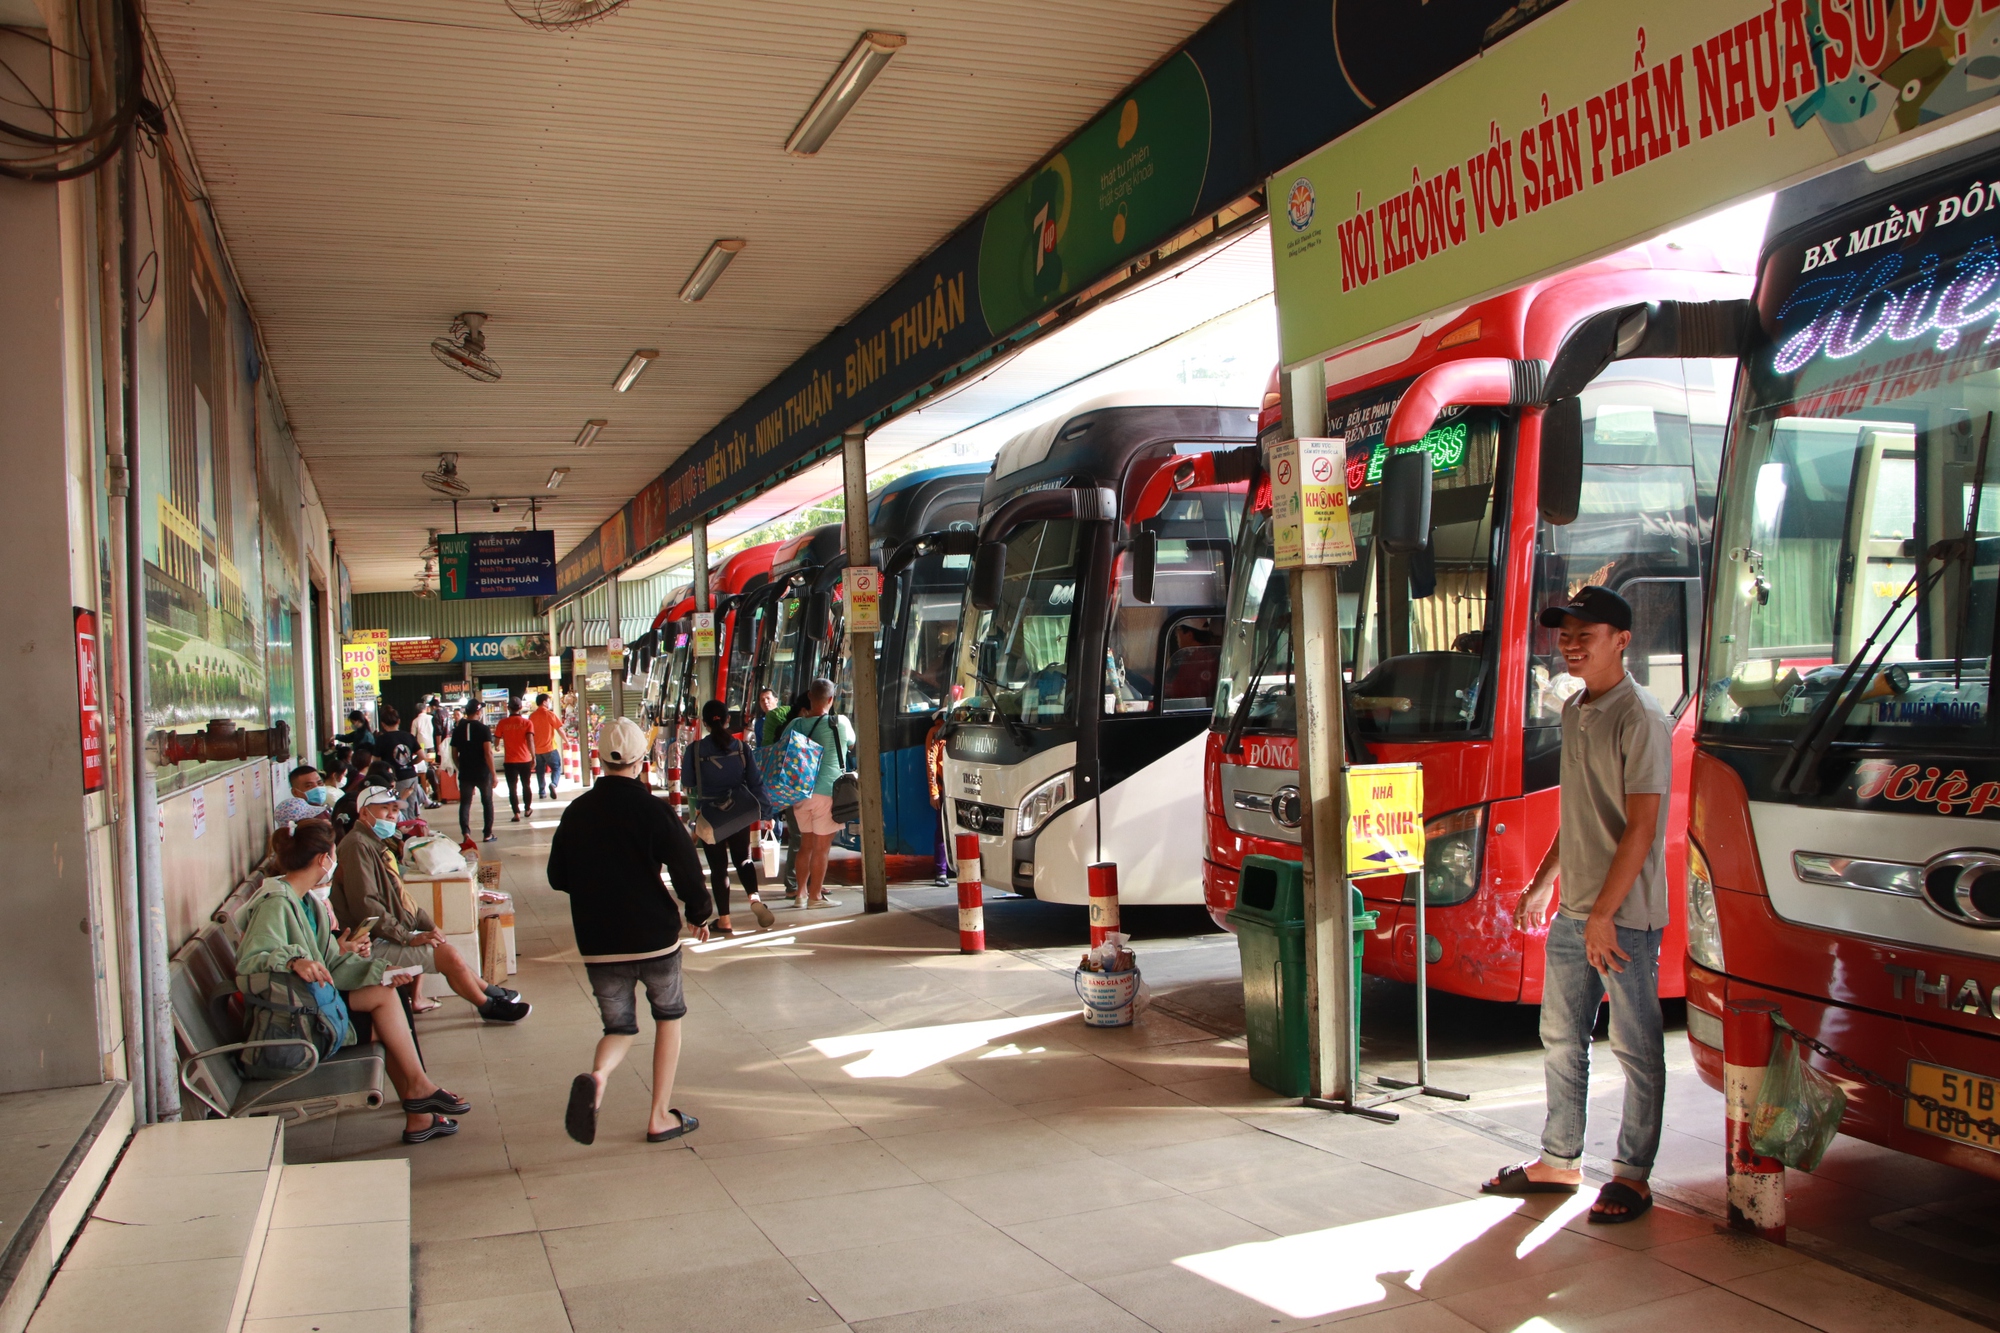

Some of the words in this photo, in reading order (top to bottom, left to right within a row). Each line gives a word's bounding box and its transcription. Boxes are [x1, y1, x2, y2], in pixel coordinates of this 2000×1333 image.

[1337, 191, 1379, 293] NÓI
[1379, 166, 1466, 276] KHÔNG
[1467, 120, 1518, 234] VỚI
[1520, 92, 1583, 214] SẢN
[1586, 26, 1691, 185] PHẨM
[1692, 0, 1817, 140] NHỰA
[1801, 237, 1842, 273] BX
[1845, 205, 1928, 257] MIỀN
[705, 440, 727, 489] MIỀN
[728, 430, 747, 475] TÂY
[755, 411, 784, 458] NINH
[785, 369, 833, 436] THUẬN
[845, 330, 887, 399] BÌNH
[891, 272, 965, 366] THUẬN
[1371, 402, 1390, 420] PHAN
[1369, 418, 1384, 436] XE
[1305, 487, 1344, 509] KHÔNG
[440, 542, 454, 555] KHU
[479, 535, 503, 546] MIỀN
[505, 538, 521, 546] TÂY
[480, 558, 504, 566] NINH
[505, 556, 539, 566] THUẬN
[447, 568, 457, 593] 1
[481, 576, 504, 585] BÌNH
[506, 575, 539, 585] THUẬN
[853, 592, 876, 604] KHÔNG
[344, 645, 375, 662] PHỞ
[470, 642, 498, 657] K.09
[351, 664, 370, 678] BÒ
[444, 684, 462, 692] BÁNH
[1250, 739, 1293, 767] ĐÔNG
[1372, 783, 1393, 800] NHÀ
[1353, 810, 1372, 843] VỆ
[1376, 811, 1414, 836] SINH
[1942, 1073, 1995, 1112] 51B
